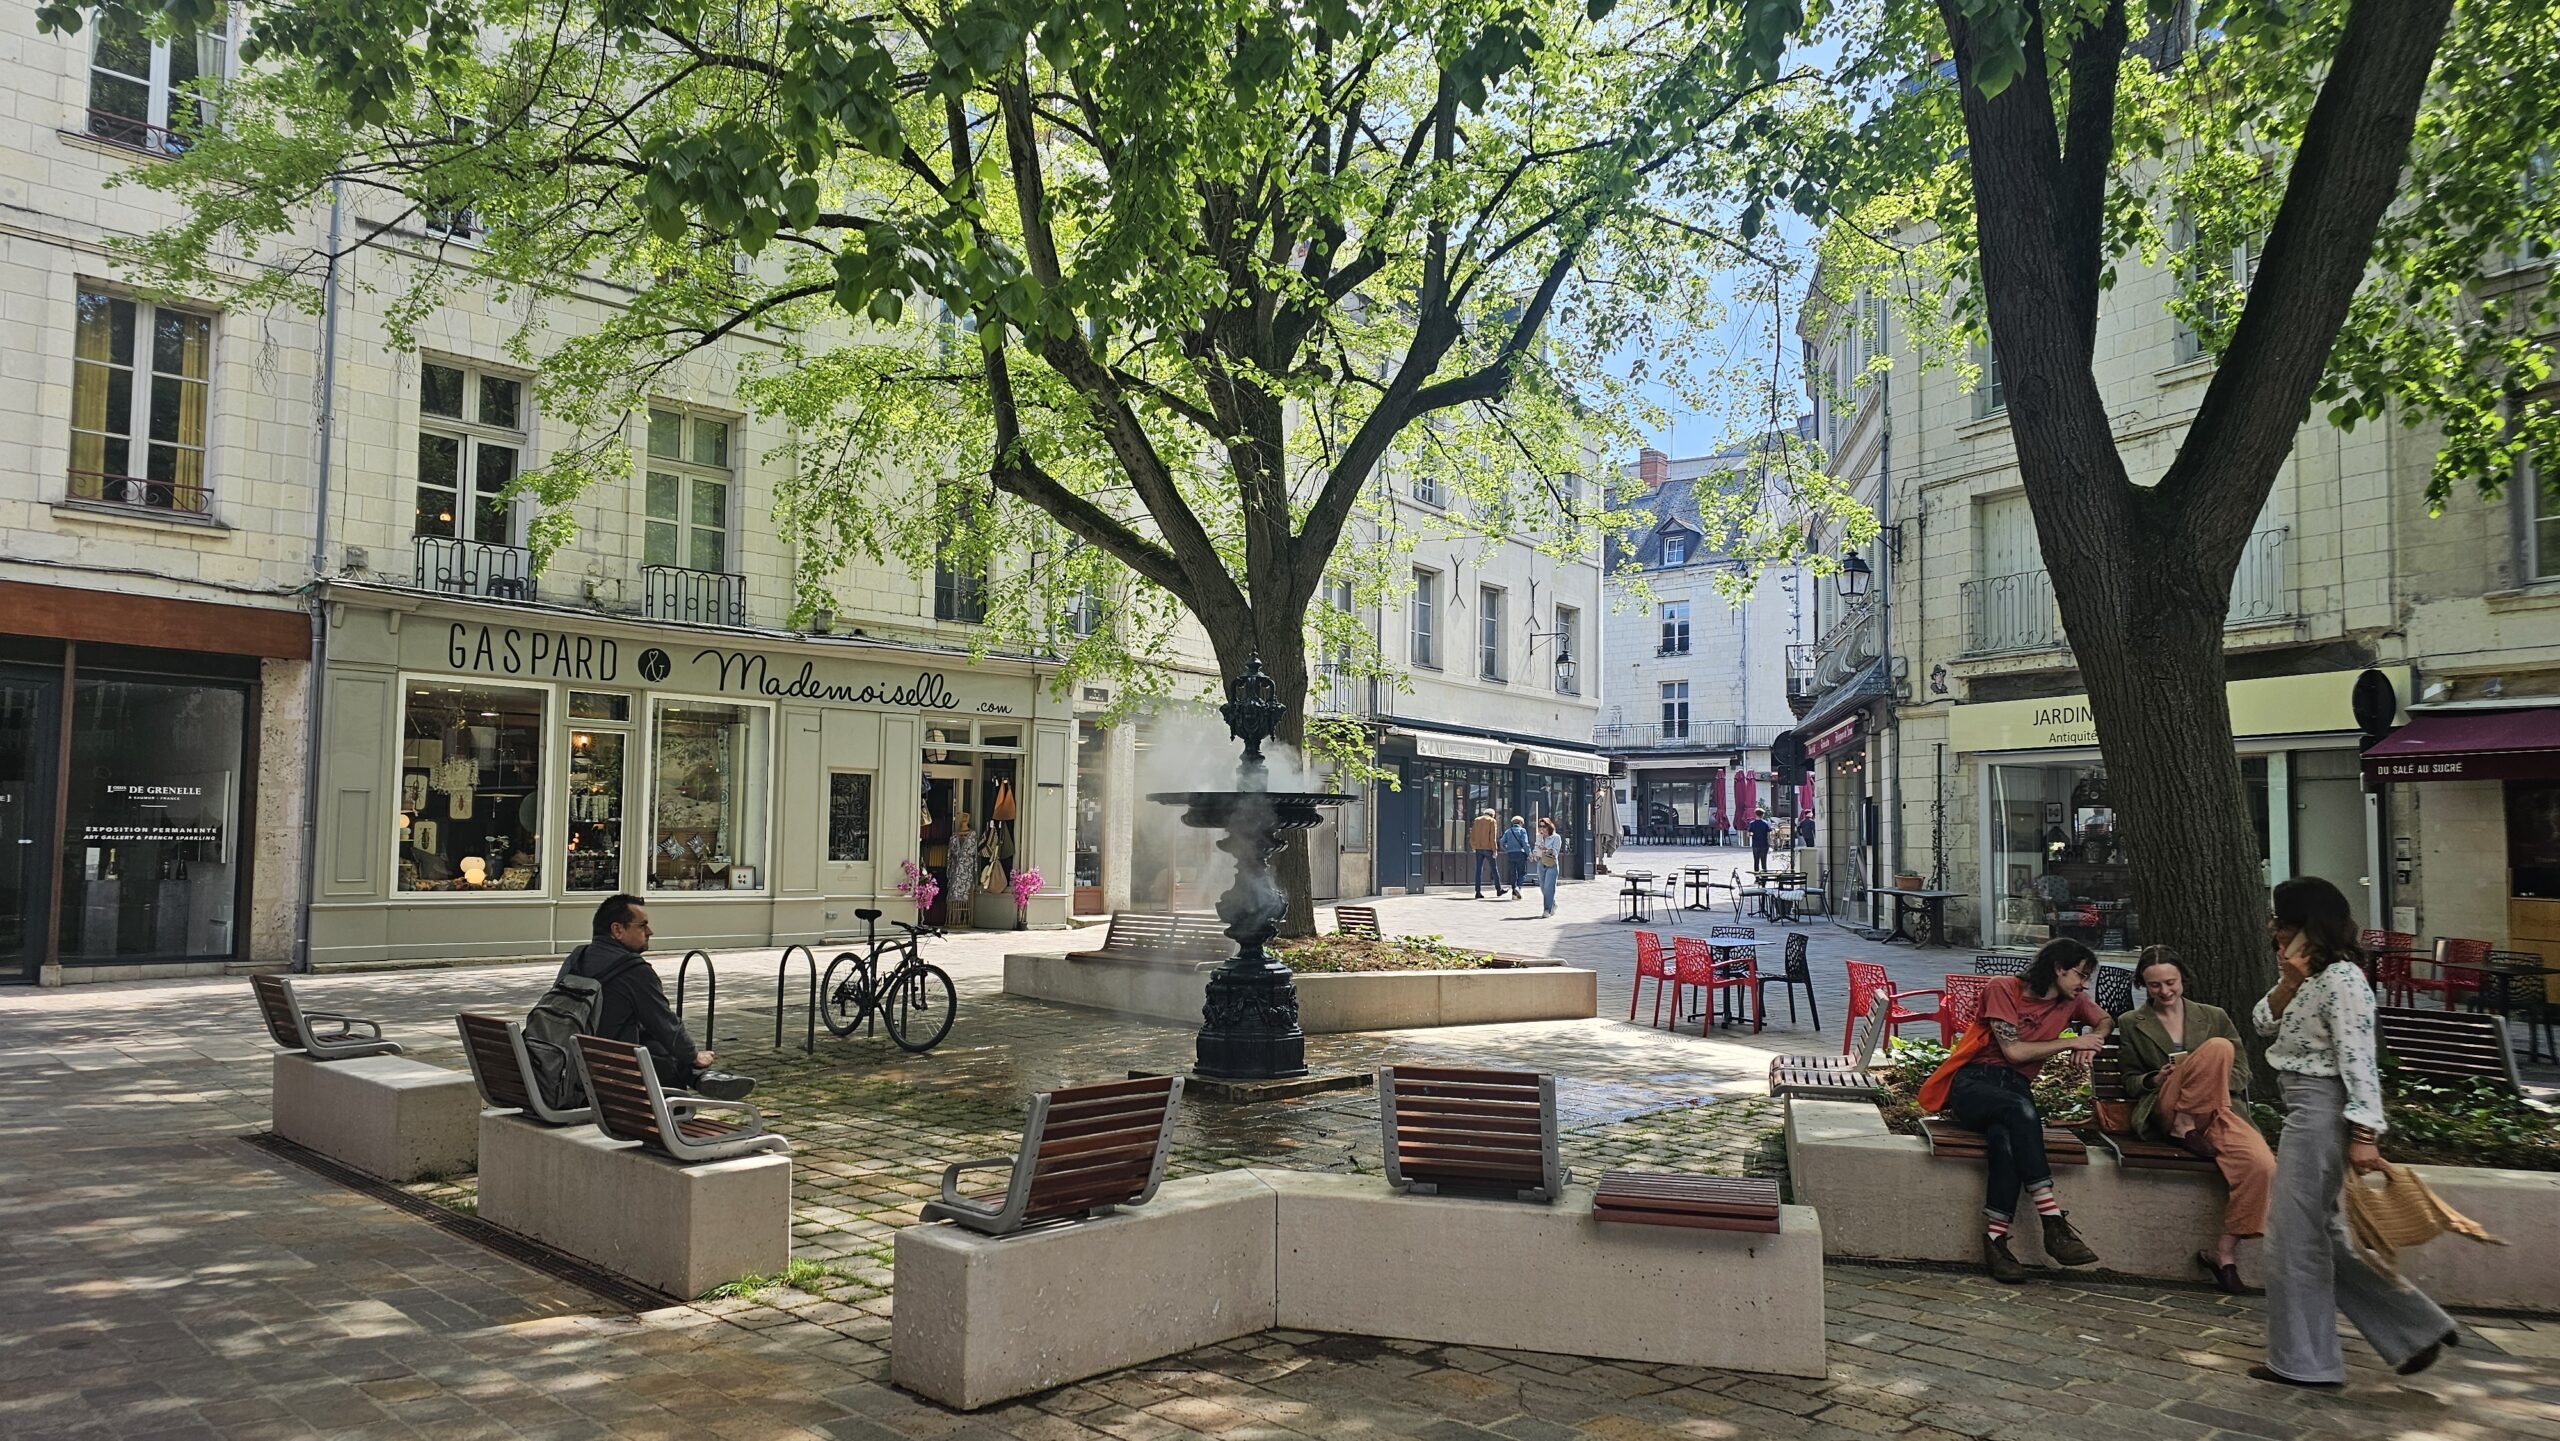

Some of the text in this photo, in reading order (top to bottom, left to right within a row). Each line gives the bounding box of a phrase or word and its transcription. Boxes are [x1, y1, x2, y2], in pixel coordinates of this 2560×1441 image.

[448, 622, 1014, 714] GASPARD & Mademoiselle .com
[2033, 706, 2093, 726] JARDIN
[2377, 762, 2463, 775] DU SALÉ AU SUCRÉ
[129, 785, 144, 794] DE
[147, 786, 202, 796] GRENELLE
